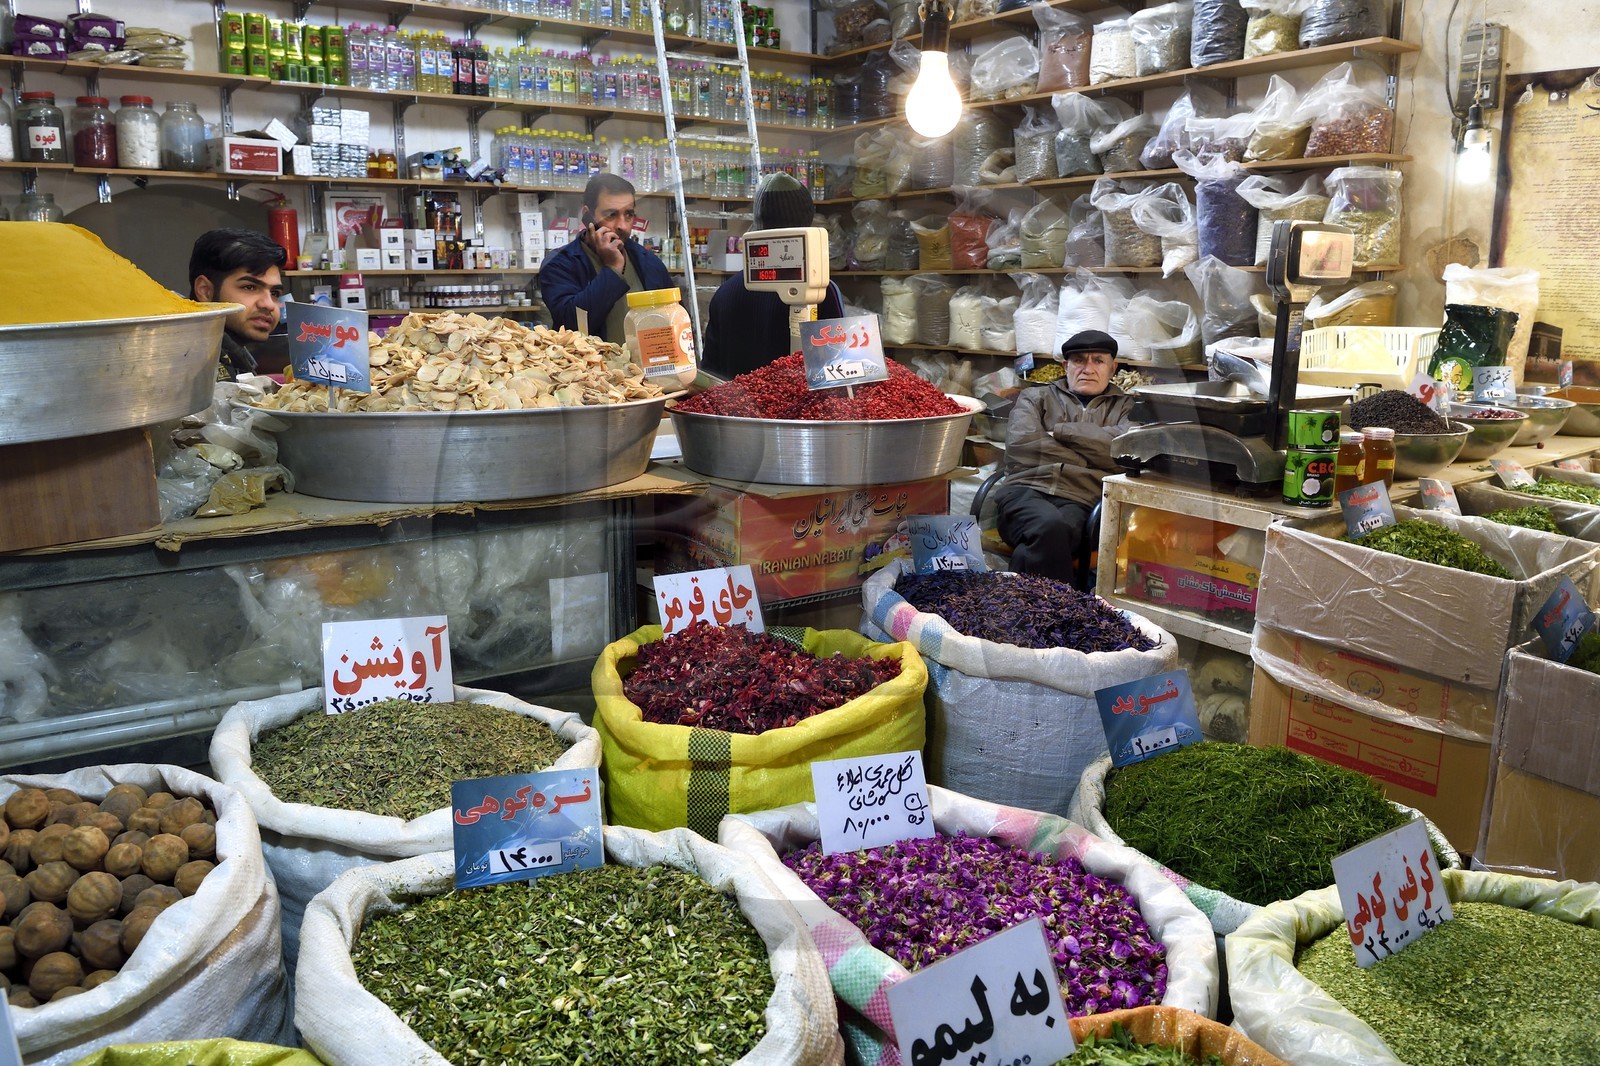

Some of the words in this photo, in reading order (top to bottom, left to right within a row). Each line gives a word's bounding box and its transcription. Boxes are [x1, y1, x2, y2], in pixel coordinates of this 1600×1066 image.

[35, 130, 56, 146] قهوه
[296, 321, 359, 349] موسیر
[811, 324, 869, 348] زرشک
[759, 555, 811, 575] IRANIAN
[813, 548, 852, 567] NABAT
[663, 576, 705, 634] قرمز
[712, 574, 753, 624] چای
[332, 624, 447, 696] آویشن
[1111, 680, 1179, 715] شوید
[465, 861, 489, 875] تومان
[499, 846, 553, 872] ۱۴۰۰۰
[1393, 849, 1434, 922] کرفس
[1347, 871, 1387, 946] کوهی
[1010, 968, 1057, 1029] به
